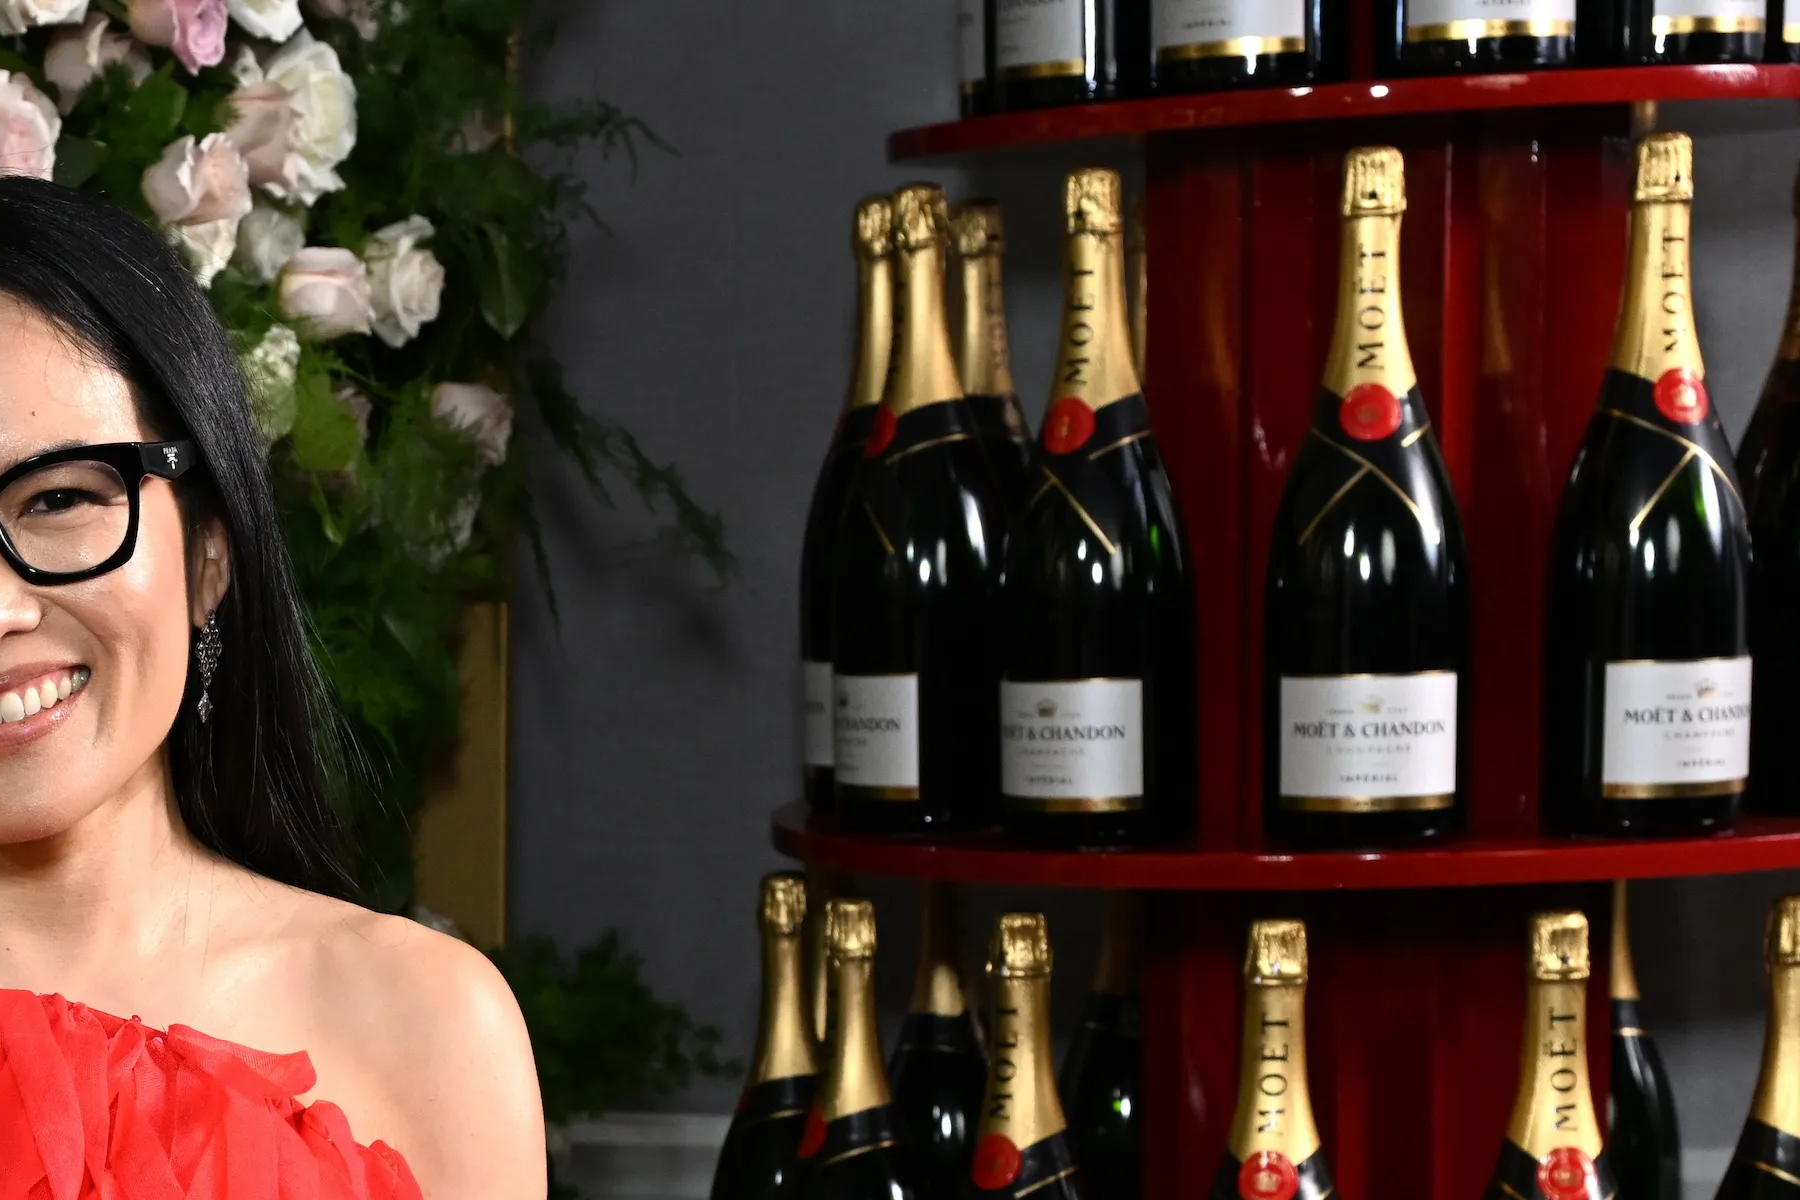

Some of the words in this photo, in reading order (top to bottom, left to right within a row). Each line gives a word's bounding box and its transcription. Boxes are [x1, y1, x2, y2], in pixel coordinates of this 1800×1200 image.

[1682, 707, 1693, 722] &
[1028, 726, 1037, 740] &
[1039, 724, 1126, 742] CHANDON
[1343, 722, 1356, 737] &
[1361, 719, 1445, 738] CHANDON
